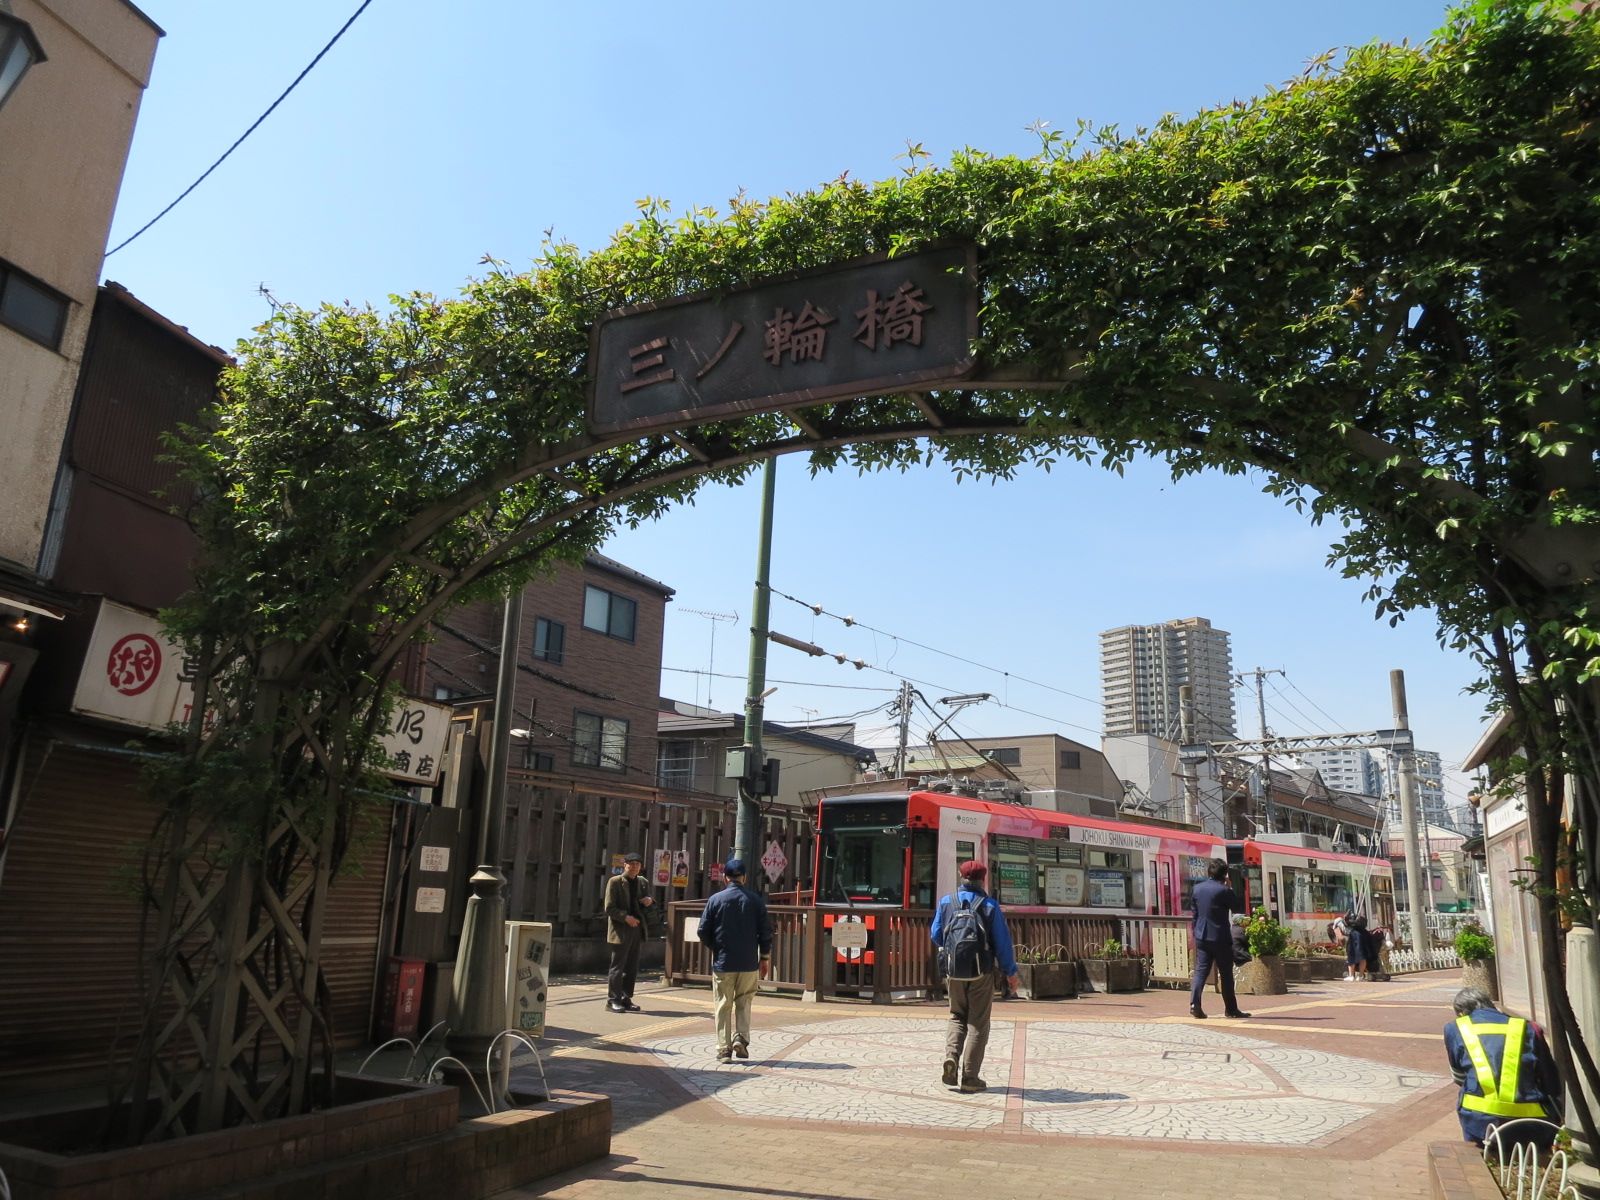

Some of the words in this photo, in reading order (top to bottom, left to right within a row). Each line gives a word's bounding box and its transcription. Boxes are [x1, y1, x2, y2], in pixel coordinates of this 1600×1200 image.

[620, 280, 934, 393] 三ノ輪橋
[395, 749, 434, 777] 商店
[1081, 828, 1107, 845] JOHOKU
[1109, 832, 1133, 847] SHINKIN
[1134, 838, 1151, 849] BANK
